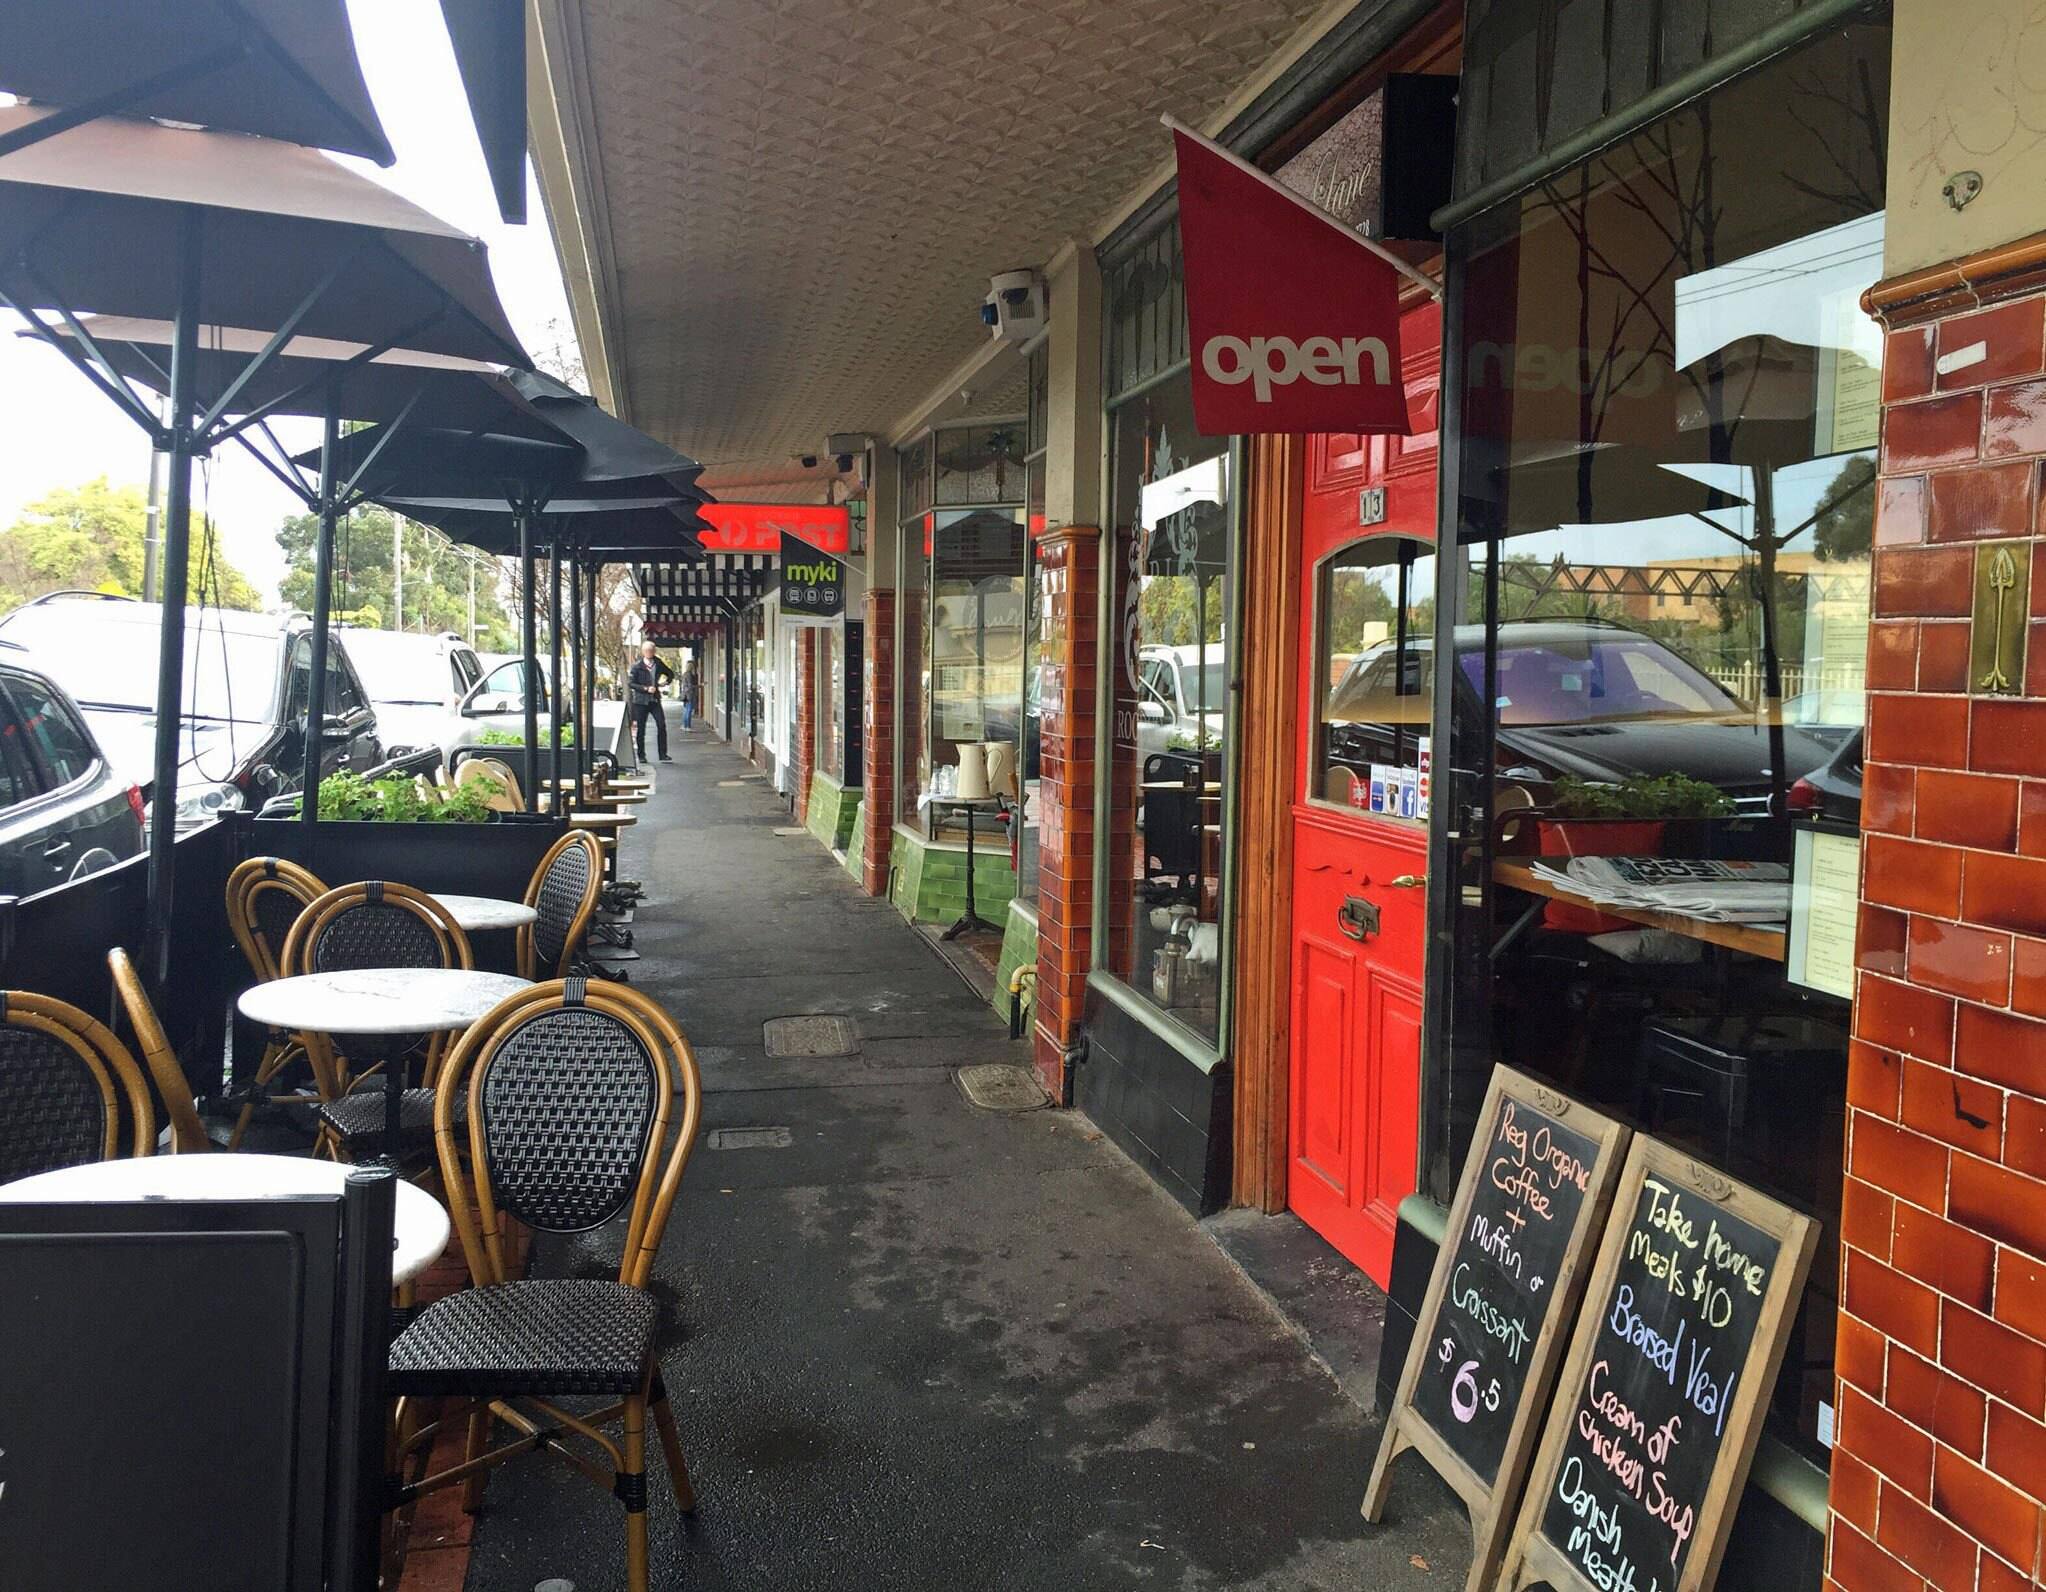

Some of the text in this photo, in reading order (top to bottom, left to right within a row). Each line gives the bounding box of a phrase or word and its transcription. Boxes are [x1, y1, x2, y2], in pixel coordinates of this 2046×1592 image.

[1202, 335, 1391, 403] open
[1363, 495, 1380, 520] 13
[786, 561, 838, 586] myki
[1498, 1102, 1528, 1167] Reg
[1492, 1157, 1554, 1220] Coffee
[1470, 1214, 1522, 1279] Muffin
[1644, 1179, 1765, 1296] Take home
[1629, 1230, 1732, 1328] Meals $10
[1590, 1360, 1682, 1465] Cream of
[1685, 1338, 1734, 1436] Veal
[1646, 1471, 1693, 1561] Soup
